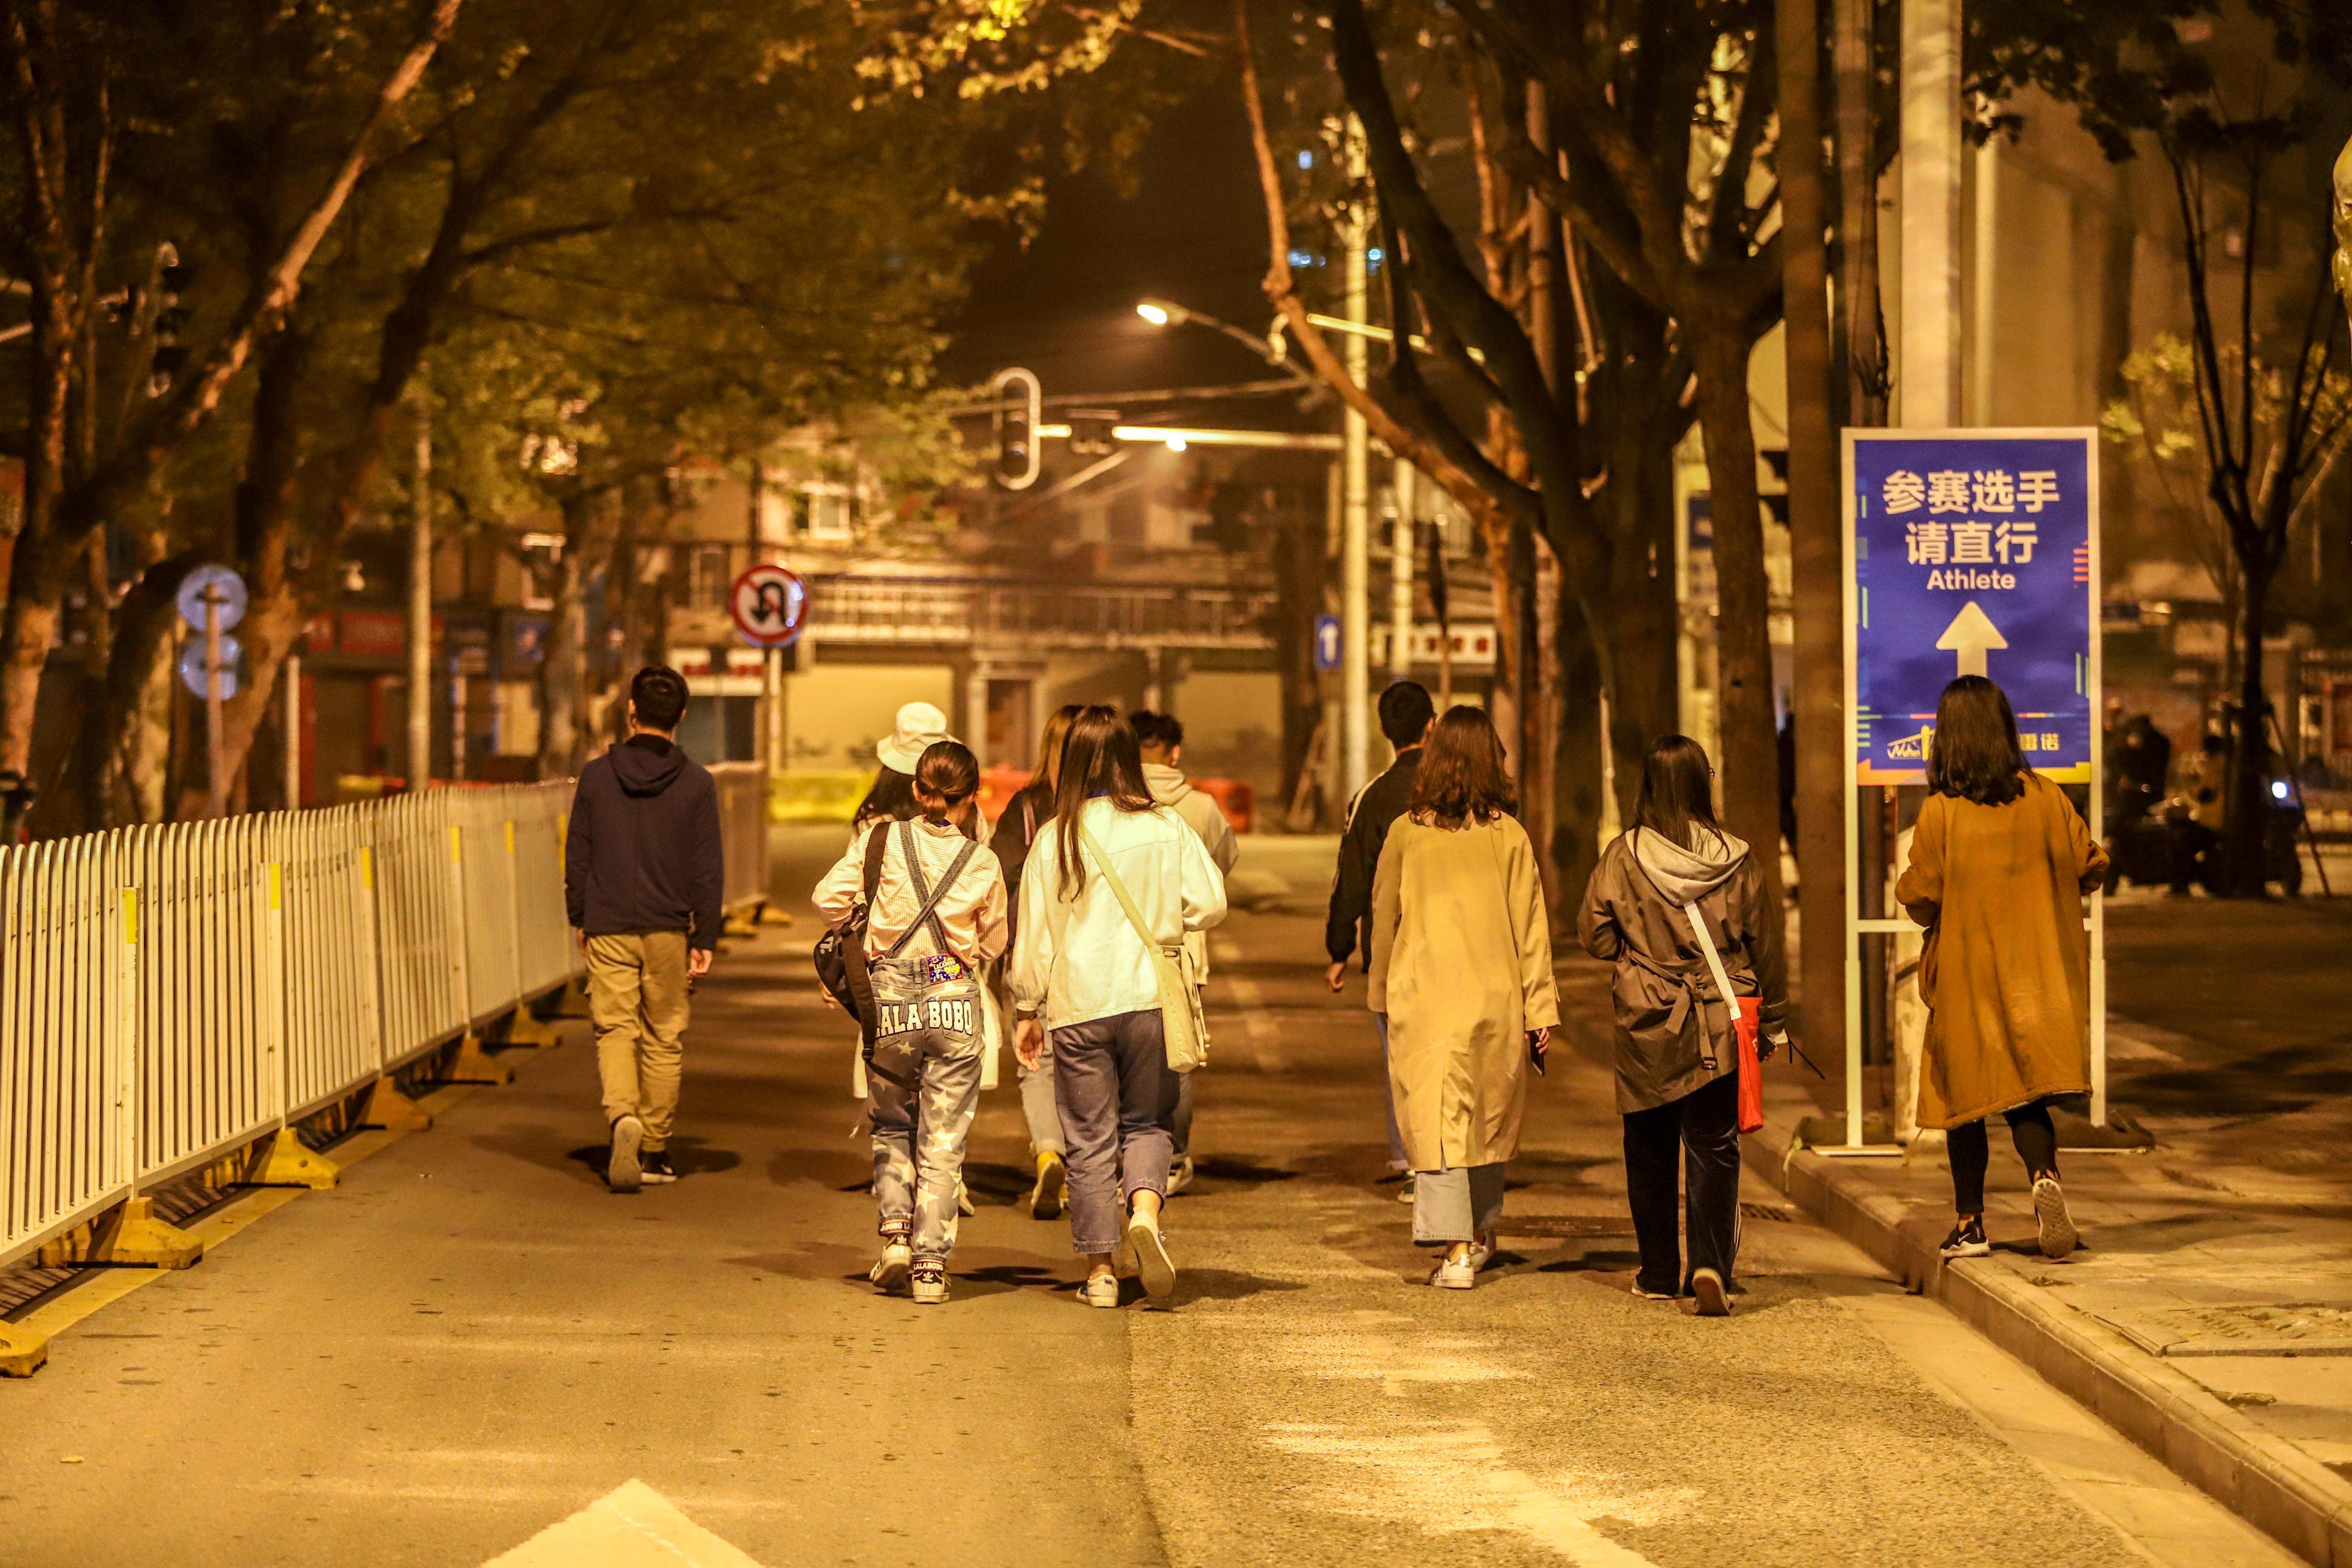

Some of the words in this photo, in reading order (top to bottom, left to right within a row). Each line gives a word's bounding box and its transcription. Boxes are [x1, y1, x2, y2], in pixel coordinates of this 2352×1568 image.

[1883, 469, 2060, 515] 参赛选手
[1905, 520, 2038, 565] 请直行
[1926, 568, 2016, 590] Athlete
[876, 1003, 923, 1039] ALA
[927, 999, 973, 1036] BOBO
[913, 1262, 943, 1271] LALABOBO
